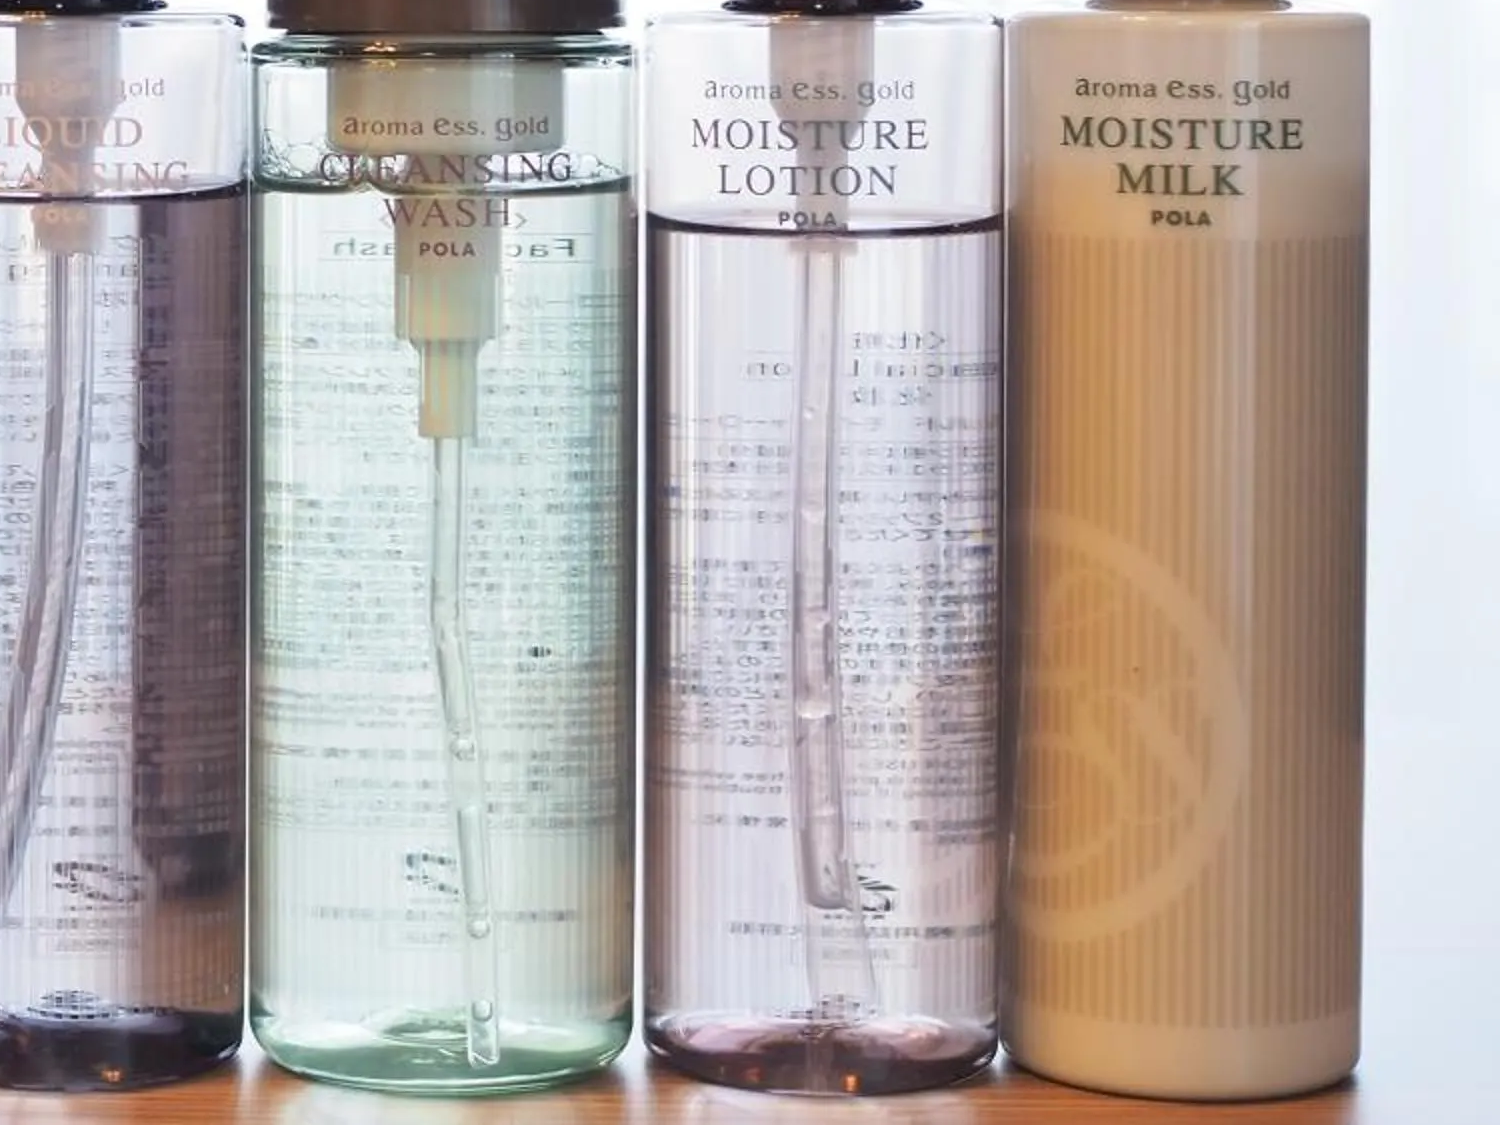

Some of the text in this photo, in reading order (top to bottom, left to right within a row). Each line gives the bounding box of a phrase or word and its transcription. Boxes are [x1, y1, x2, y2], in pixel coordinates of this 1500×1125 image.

[704, 80, 915, 107] aroma ess. gold
[1074, 77, 1291, 106] aroma ess. gold
[342, 116, 550, 142] aroma ess. gold
[692, 118, 930, 151] MOISTURE
[1059, 115, 1304, 151] MOISTURE
[319, 152, 573, 187] CLEANSING
[718, 163, 899, 197] LOTION
[1116, 162, 1245, 197] MILK
[383, 198, 510, 229] WASH
[778, 210, 837, 227] POLA
[1150, 209, 1213, 227] POLA
[418, 241, 476, 258] POLA
